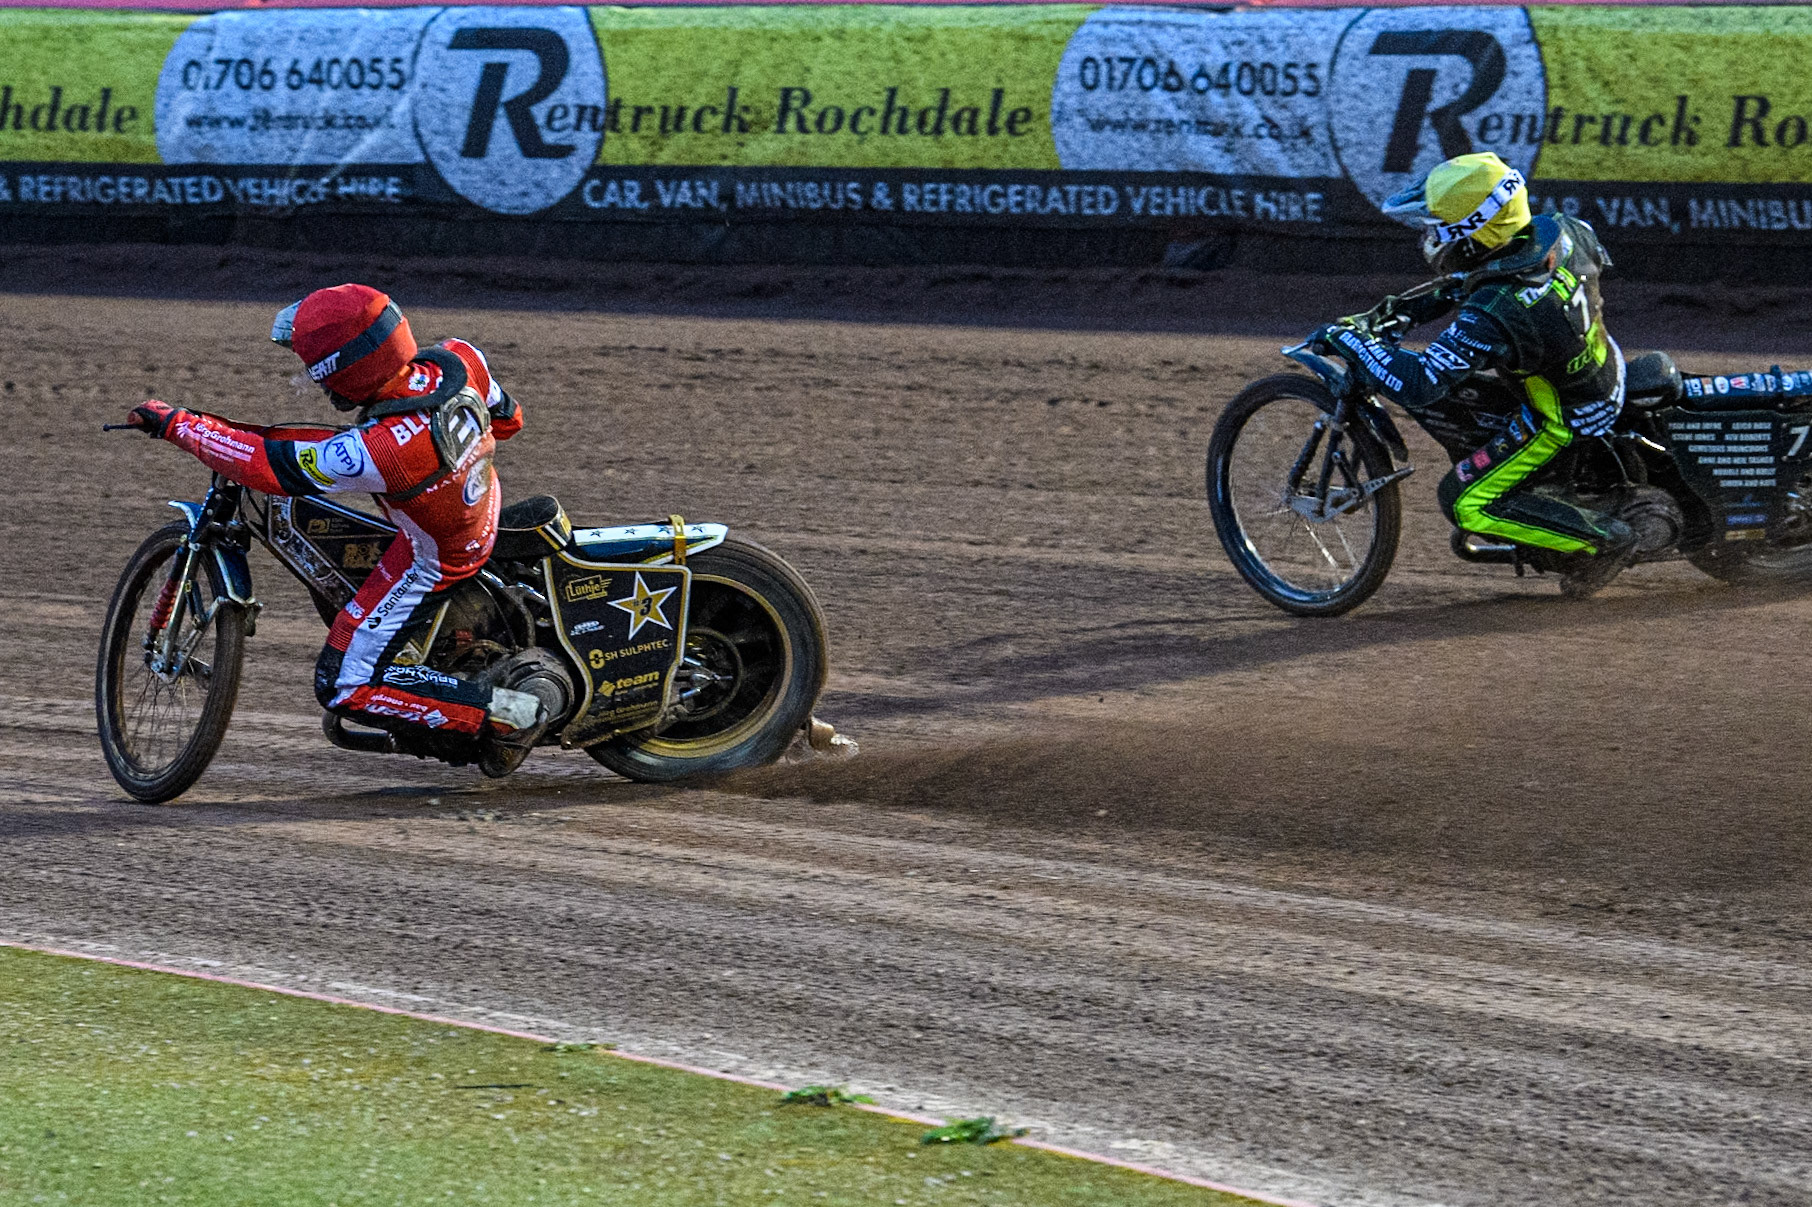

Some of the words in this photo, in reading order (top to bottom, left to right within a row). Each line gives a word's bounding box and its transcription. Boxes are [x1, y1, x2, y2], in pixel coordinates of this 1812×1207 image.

[285, 57, 406, 92] 640055
[1079, 56, 1184, 92] 01706
[1191, 61, 1322, 97] 640055
[0, 85, 139, 133] hdale
[773, 86, 1034, 138] Rochdale
[1725, 95, 1809, 149] Ro
[20, 175, 223, 204] REFRIGERATED
[223, 176, 330, 206] VEHICLE
[735, 181, 861, 213] MINIBUS
[870, 182, 895, 212] &
[902, 182, 1118, 217] REFRIGERATED
[1126, 186, 1247, 217] VEHICLE
[1253, 190, 1324, 223] HIRE
[331, 440, 357, 471] ATPI
[1789, 425, 1811, 457] 7
[376, 568, 420, 618] Santander
[604, 650, 619, 661] SH
[616, 671, 660, 689] team
